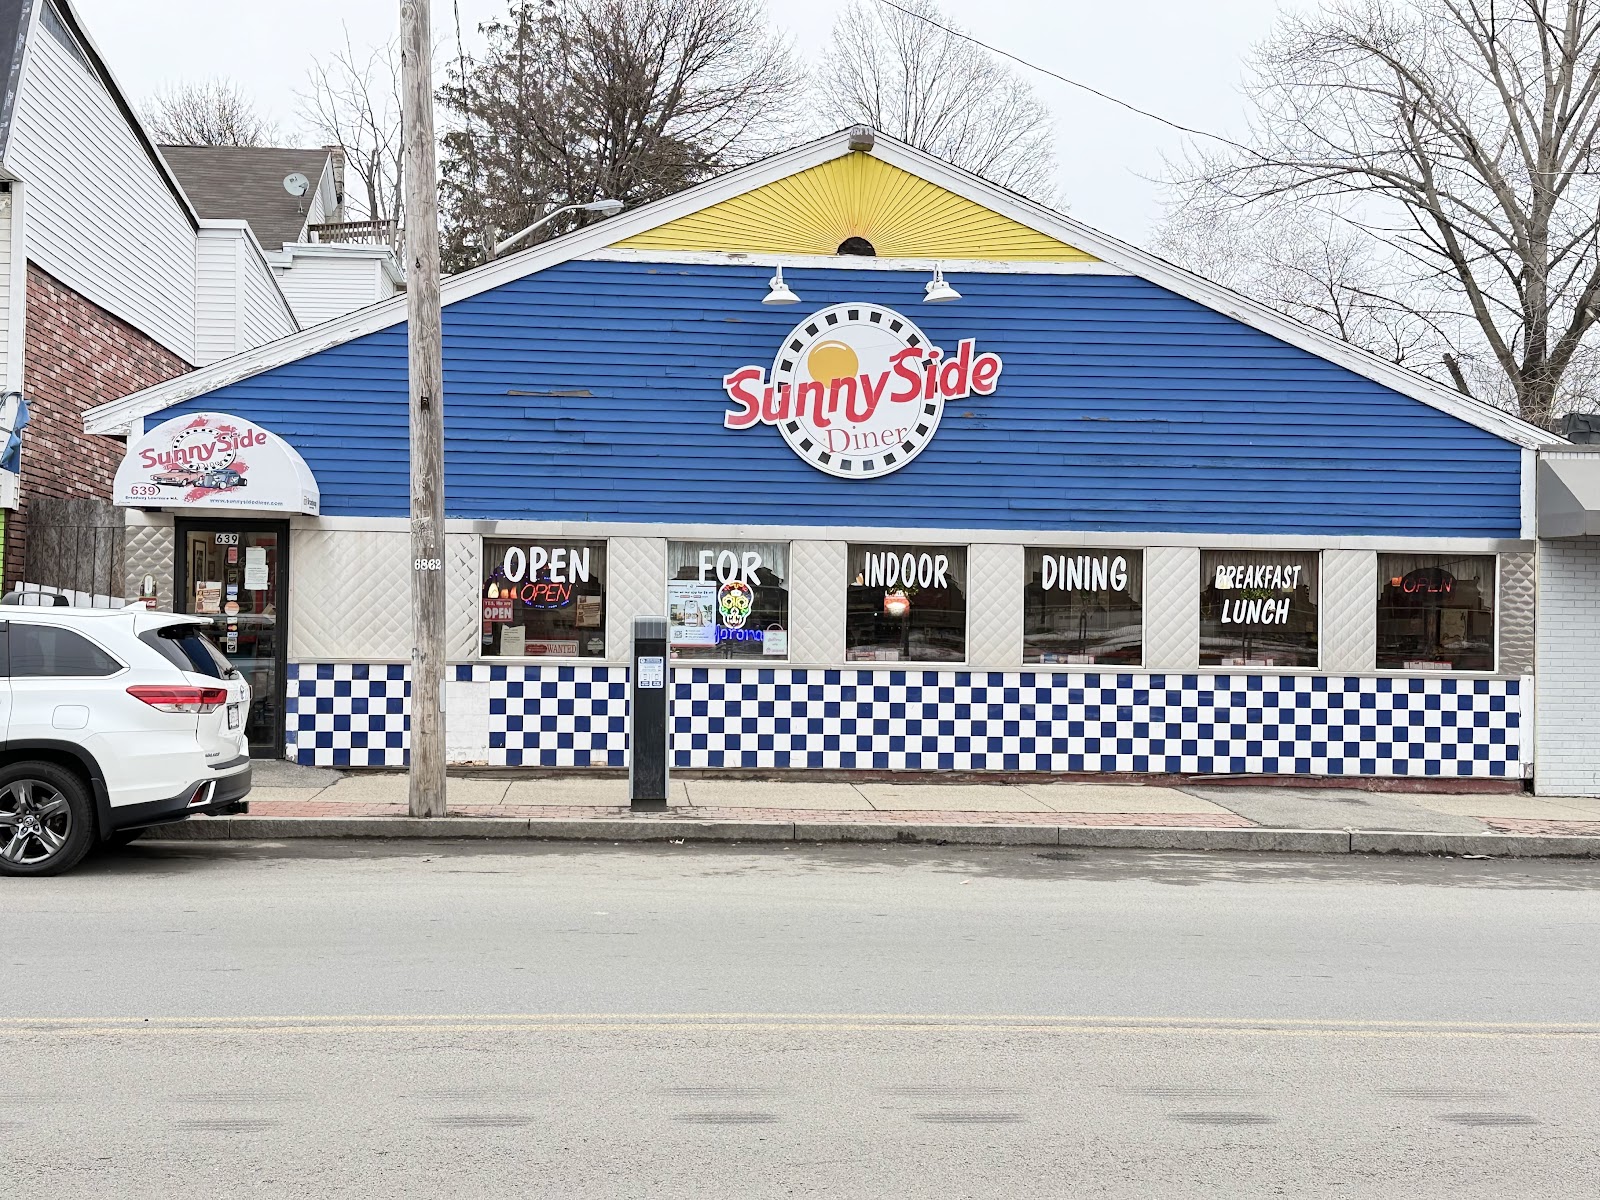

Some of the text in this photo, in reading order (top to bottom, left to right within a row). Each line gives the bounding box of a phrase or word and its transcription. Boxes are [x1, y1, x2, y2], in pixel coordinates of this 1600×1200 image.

[825, 426, 908, 453] Diner
[131, 486, 156, 496] 639
[216, 534, 238, 544] 639
[503, 546, 590, 583] OPEN
[699, 549, 762, 586] FOR
[864, 551, 949, 589] INDOOR
[1041, 555, 1127, 592] DINING
[1214, 565, 1302, 590] BREAKFAST
[1403, 577, 1453, 593] OPEN
[520, 583, 572, 601] OPEN
[484, 607, 512, 619] OPEN
[1221, 598, 1290, 625] LUNCH
[546, 644, 577, 654] WANTED
